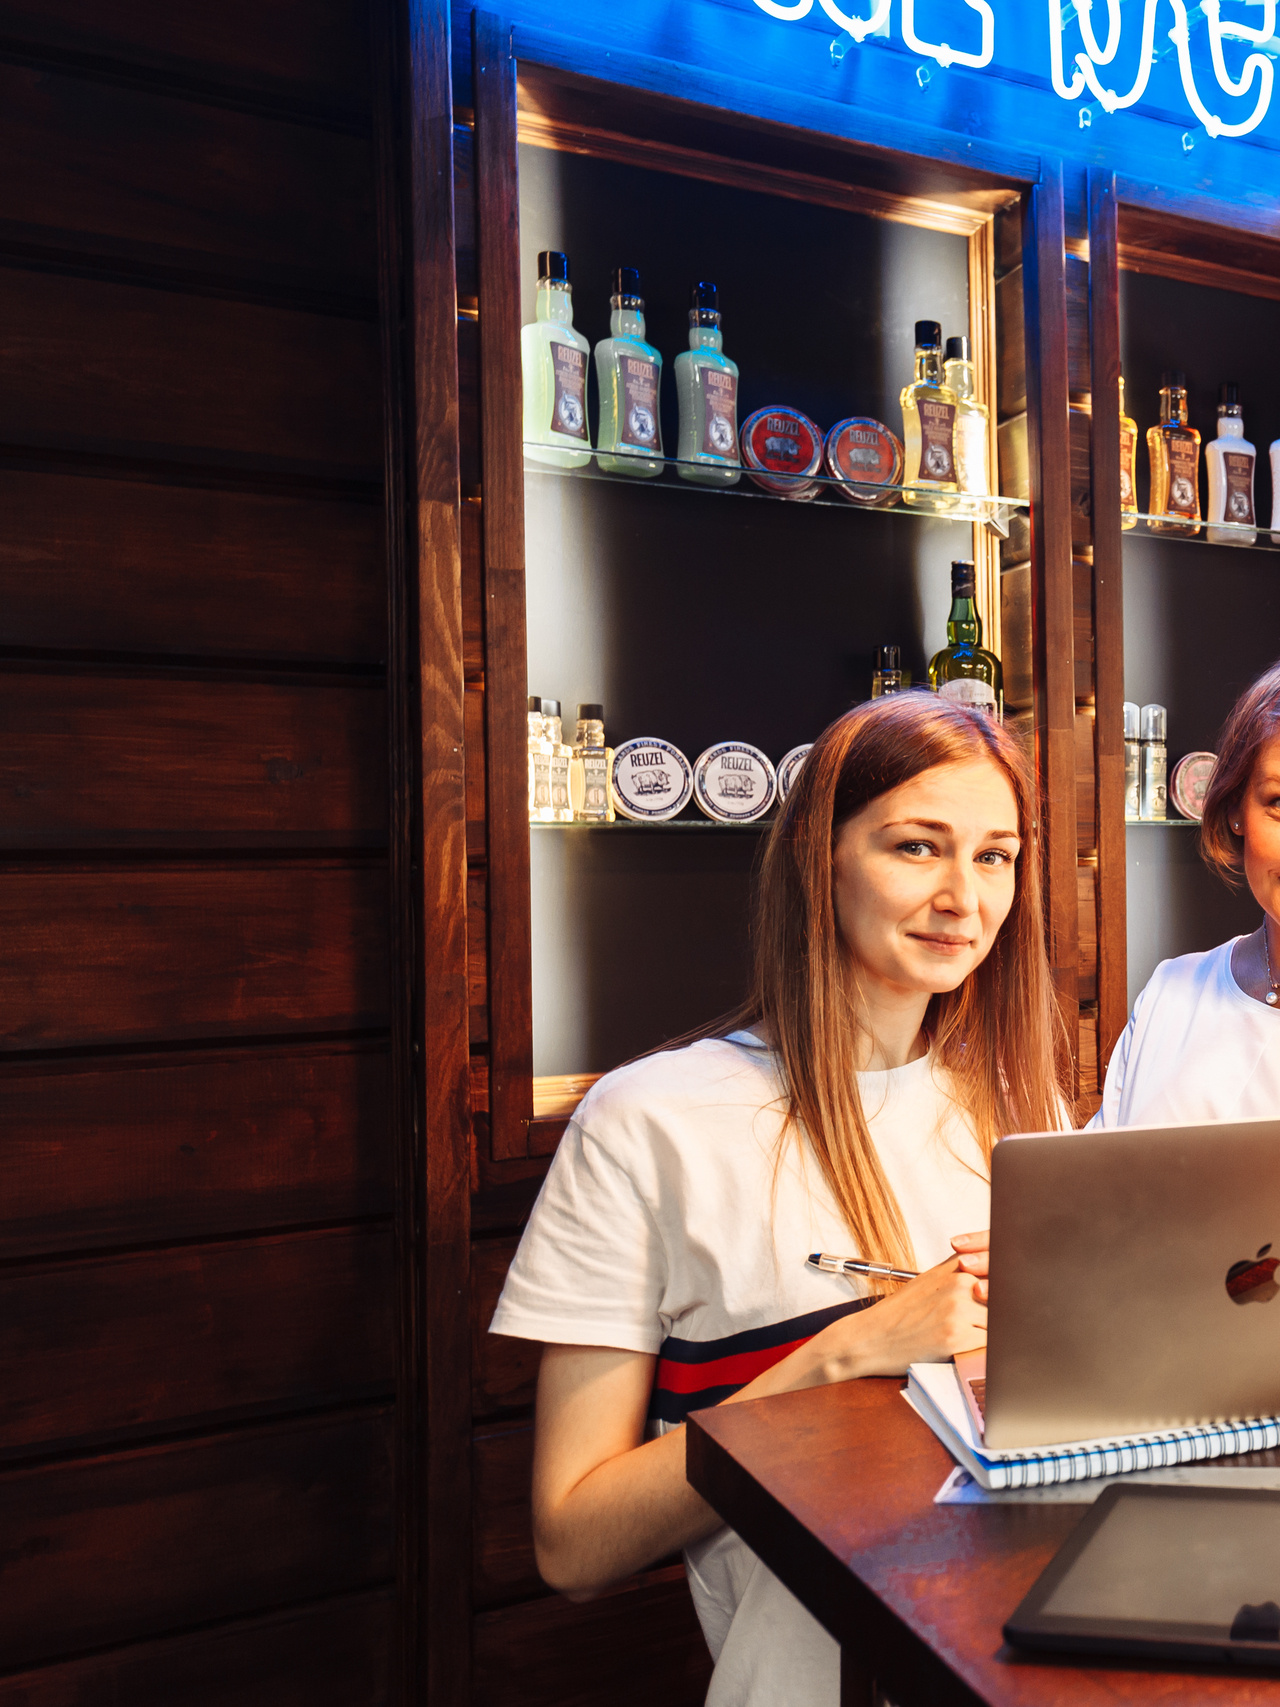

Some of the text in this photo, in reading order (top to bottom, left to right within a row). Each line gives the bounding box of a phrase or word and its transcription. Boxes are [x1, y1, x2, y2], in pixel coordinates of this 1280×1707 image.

[627, 358, 654, 379] REUZEL
[766, 417, 800, 436] REUZEL
[850, 430, 880, 446] REUZEL
[630, 752, 666, 767] REUZEL
[721, 756, 754, 771] REUZEL
